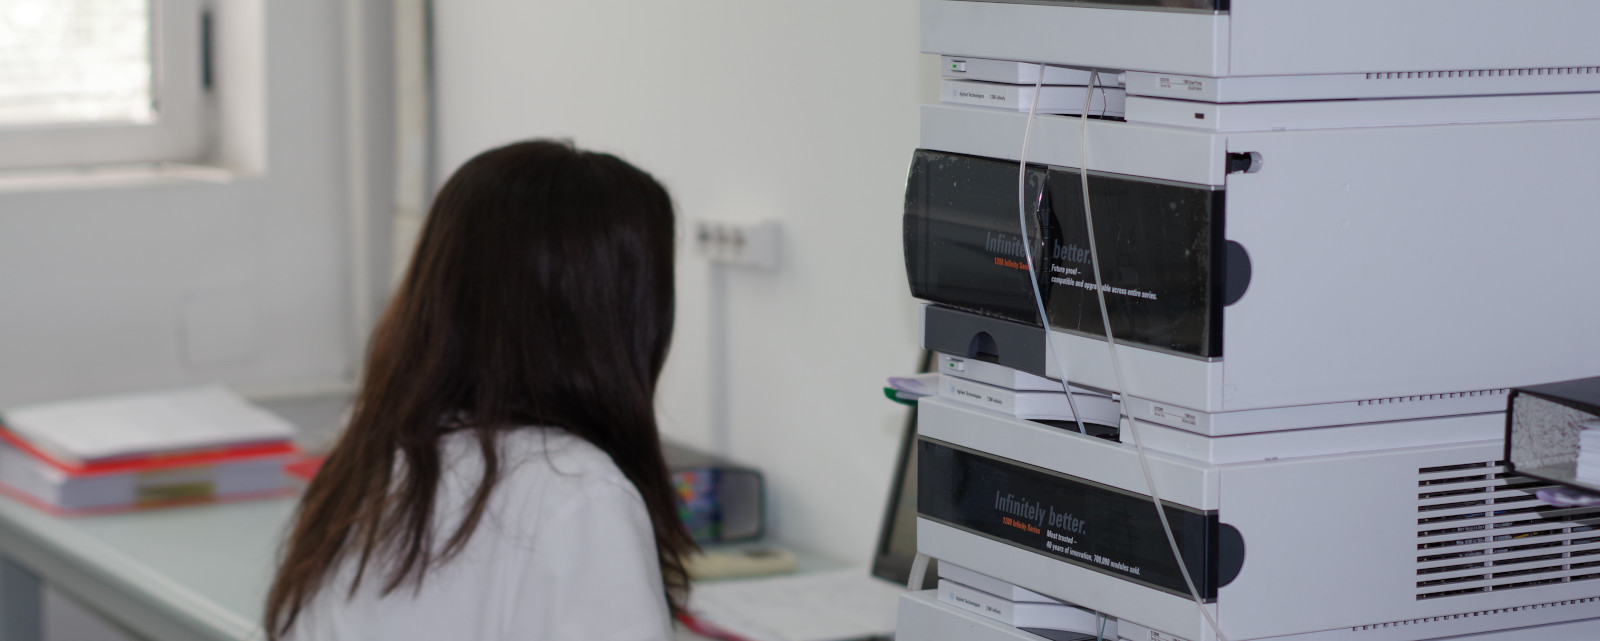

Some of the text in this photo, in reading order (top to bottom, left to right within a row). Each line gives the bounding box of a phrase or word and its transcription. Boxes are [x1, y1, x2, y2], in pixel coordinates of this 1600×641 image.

[986, 231, 1091, 265] Infinitey better.
[1004, 258, 1019, 270] Infinity
[1051, 263, 1065, 273] Future
[1065, 267, 1077, 276] proof
[1051, 276, 1157, 300] compatible and upgraable across entire series.
[995, 490, 1086, 535] Infinitely better.
[1012, 519, 1028, 532] Infinity
[1027, 523, 1041, 535] Series
[1046, 529, 1059, 539] Most
[1057, 533, 1074, 544] trusted
[1046, 540, 1053, 549] 40
[1052, 544, 1064, 553] years
[1064, 546, 1070, 554] of
[1069, 548, 1093, 562] innovation,
[1110, 560, 1130, 572] modules
[1129, 566, 1141, 576] sold.
